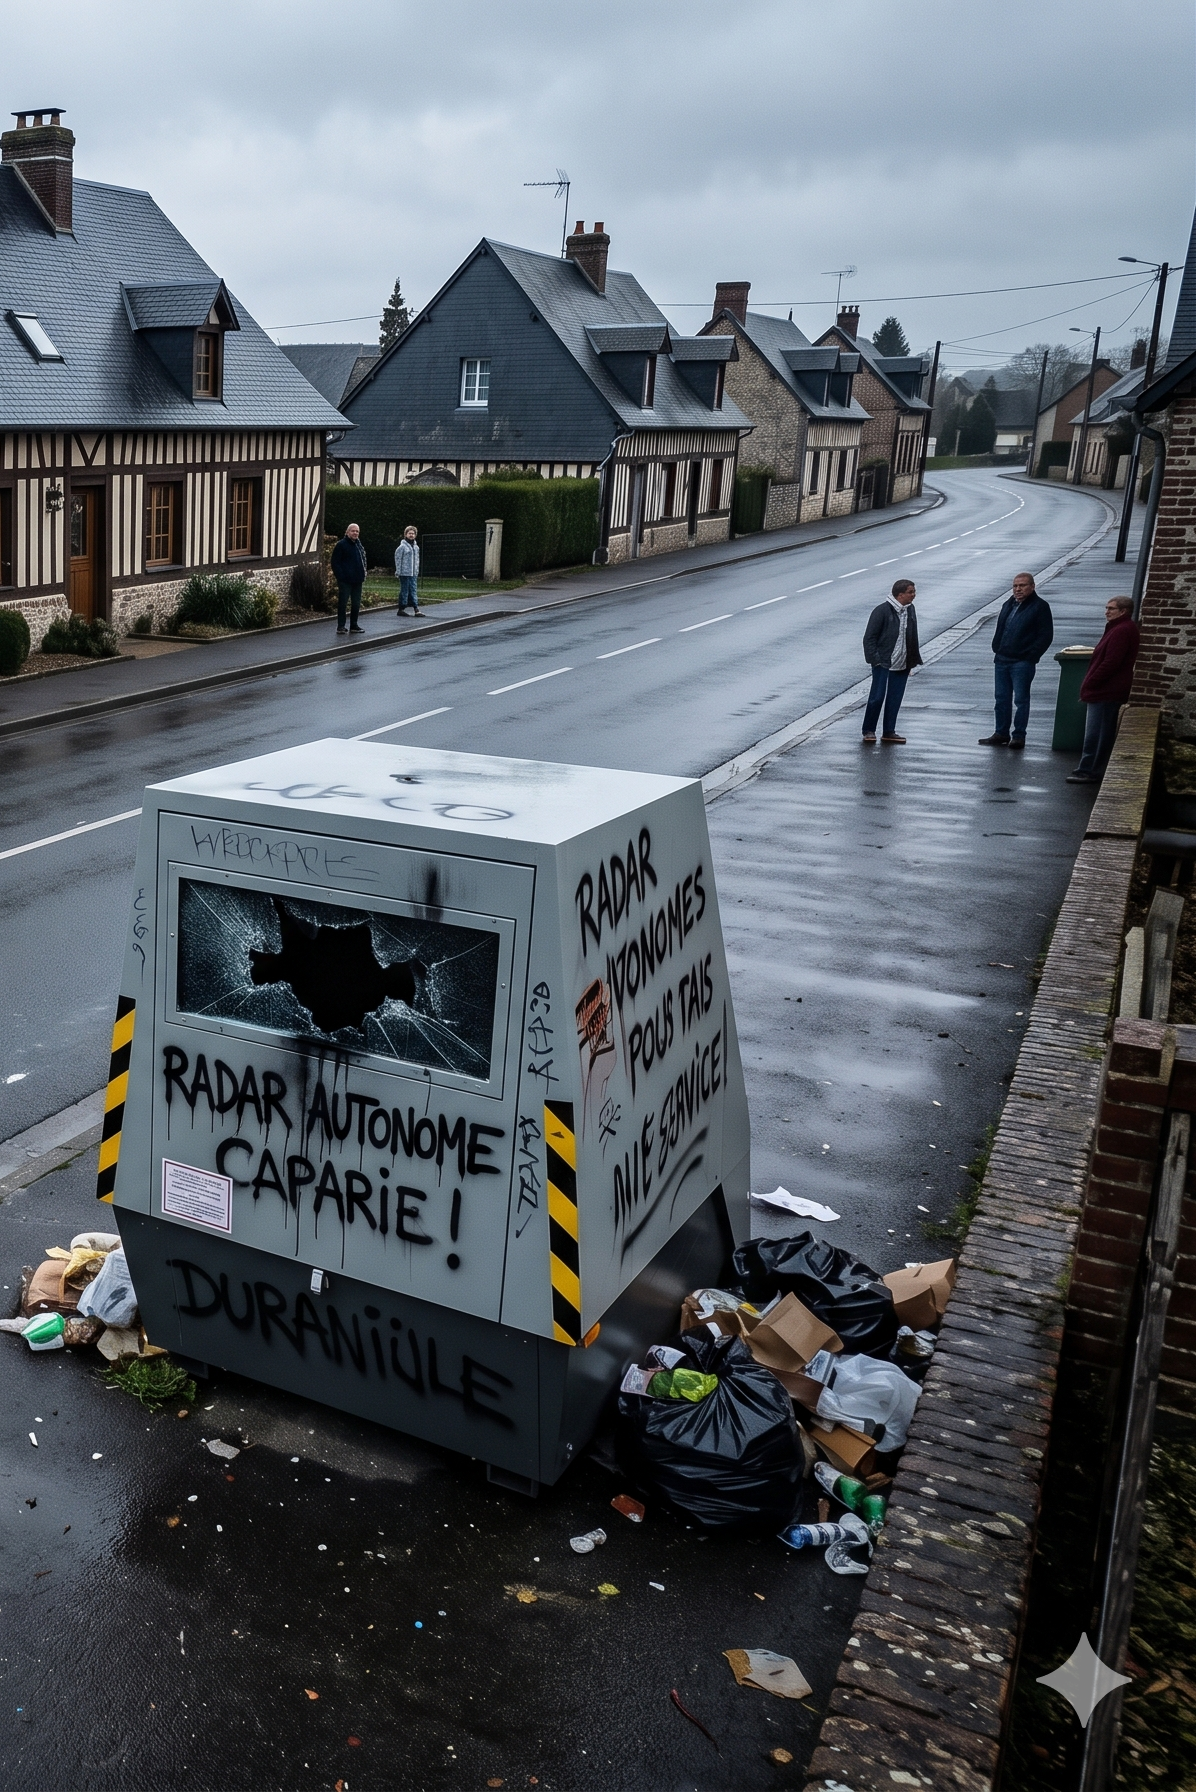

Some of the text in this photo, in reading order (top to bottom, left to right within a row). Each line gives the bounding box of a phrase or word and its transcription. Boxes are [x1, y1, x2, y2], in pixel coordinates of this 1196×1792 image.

[574, 827, 658, 958] RADAR
[678, 952, 713, 1036] TAIS
[162, 1045, 293, 1132] RADAR
[305, 1080, 506, 1179] AUTONOME
